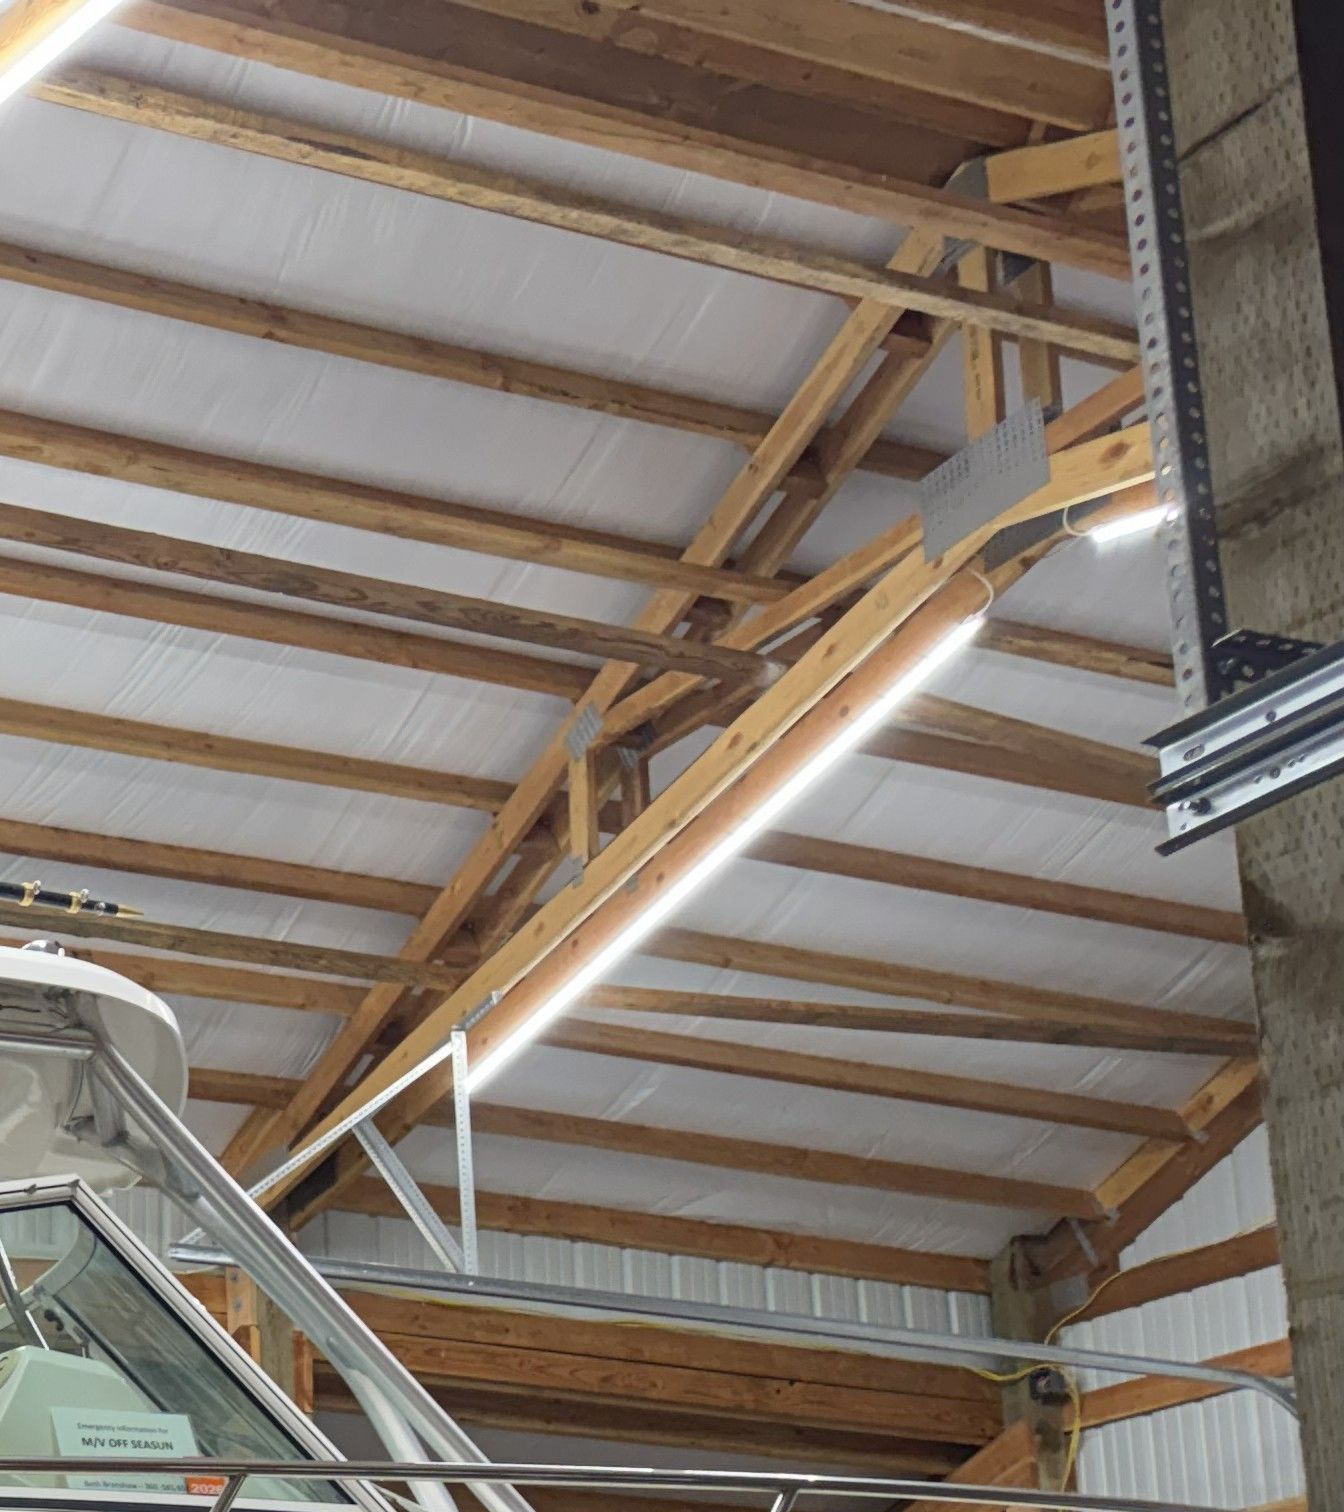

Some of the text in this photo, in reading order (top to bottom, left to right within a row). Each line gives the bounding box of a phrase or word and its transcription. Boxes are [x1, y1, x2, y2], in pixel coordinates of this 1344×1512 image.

[81, 1437, 174, 1450] M/V OFF SEASUN
